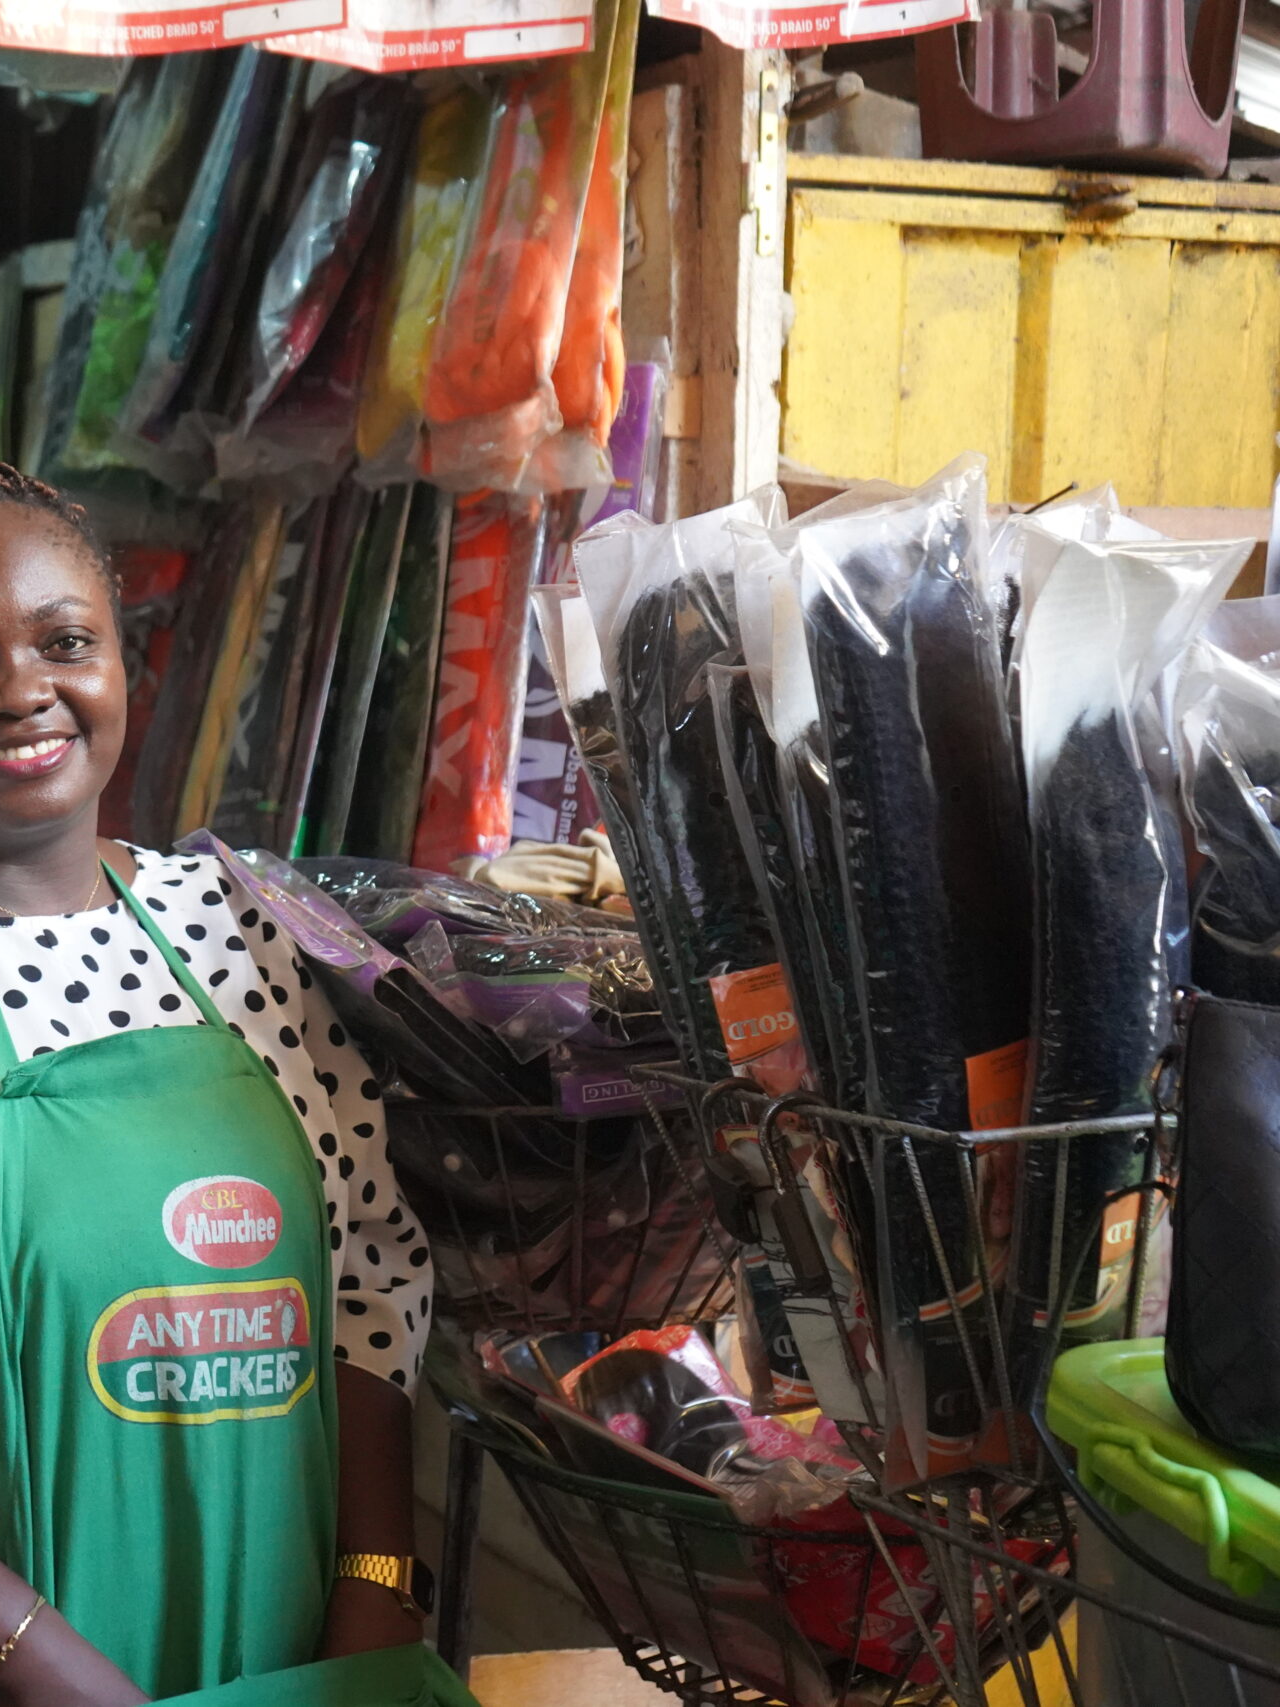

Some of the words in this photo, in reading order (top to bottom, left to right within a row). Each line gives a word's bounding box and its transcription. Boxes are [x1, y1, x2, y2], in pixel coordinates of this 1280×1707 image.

[166, 21, 198, 38] BRAID
[781, 18, 813, 35] BRAID
[407, 41, 440, 56] BRAID
[563, 745, 583, 794] Obaa
[727, 1011, 795, 1040] GOLD
[201, 1189, 244, 1209] CBL
[186, 1210, 276, 1246] Munchee
[126, 1351, 301, 1402] CRACKERS
